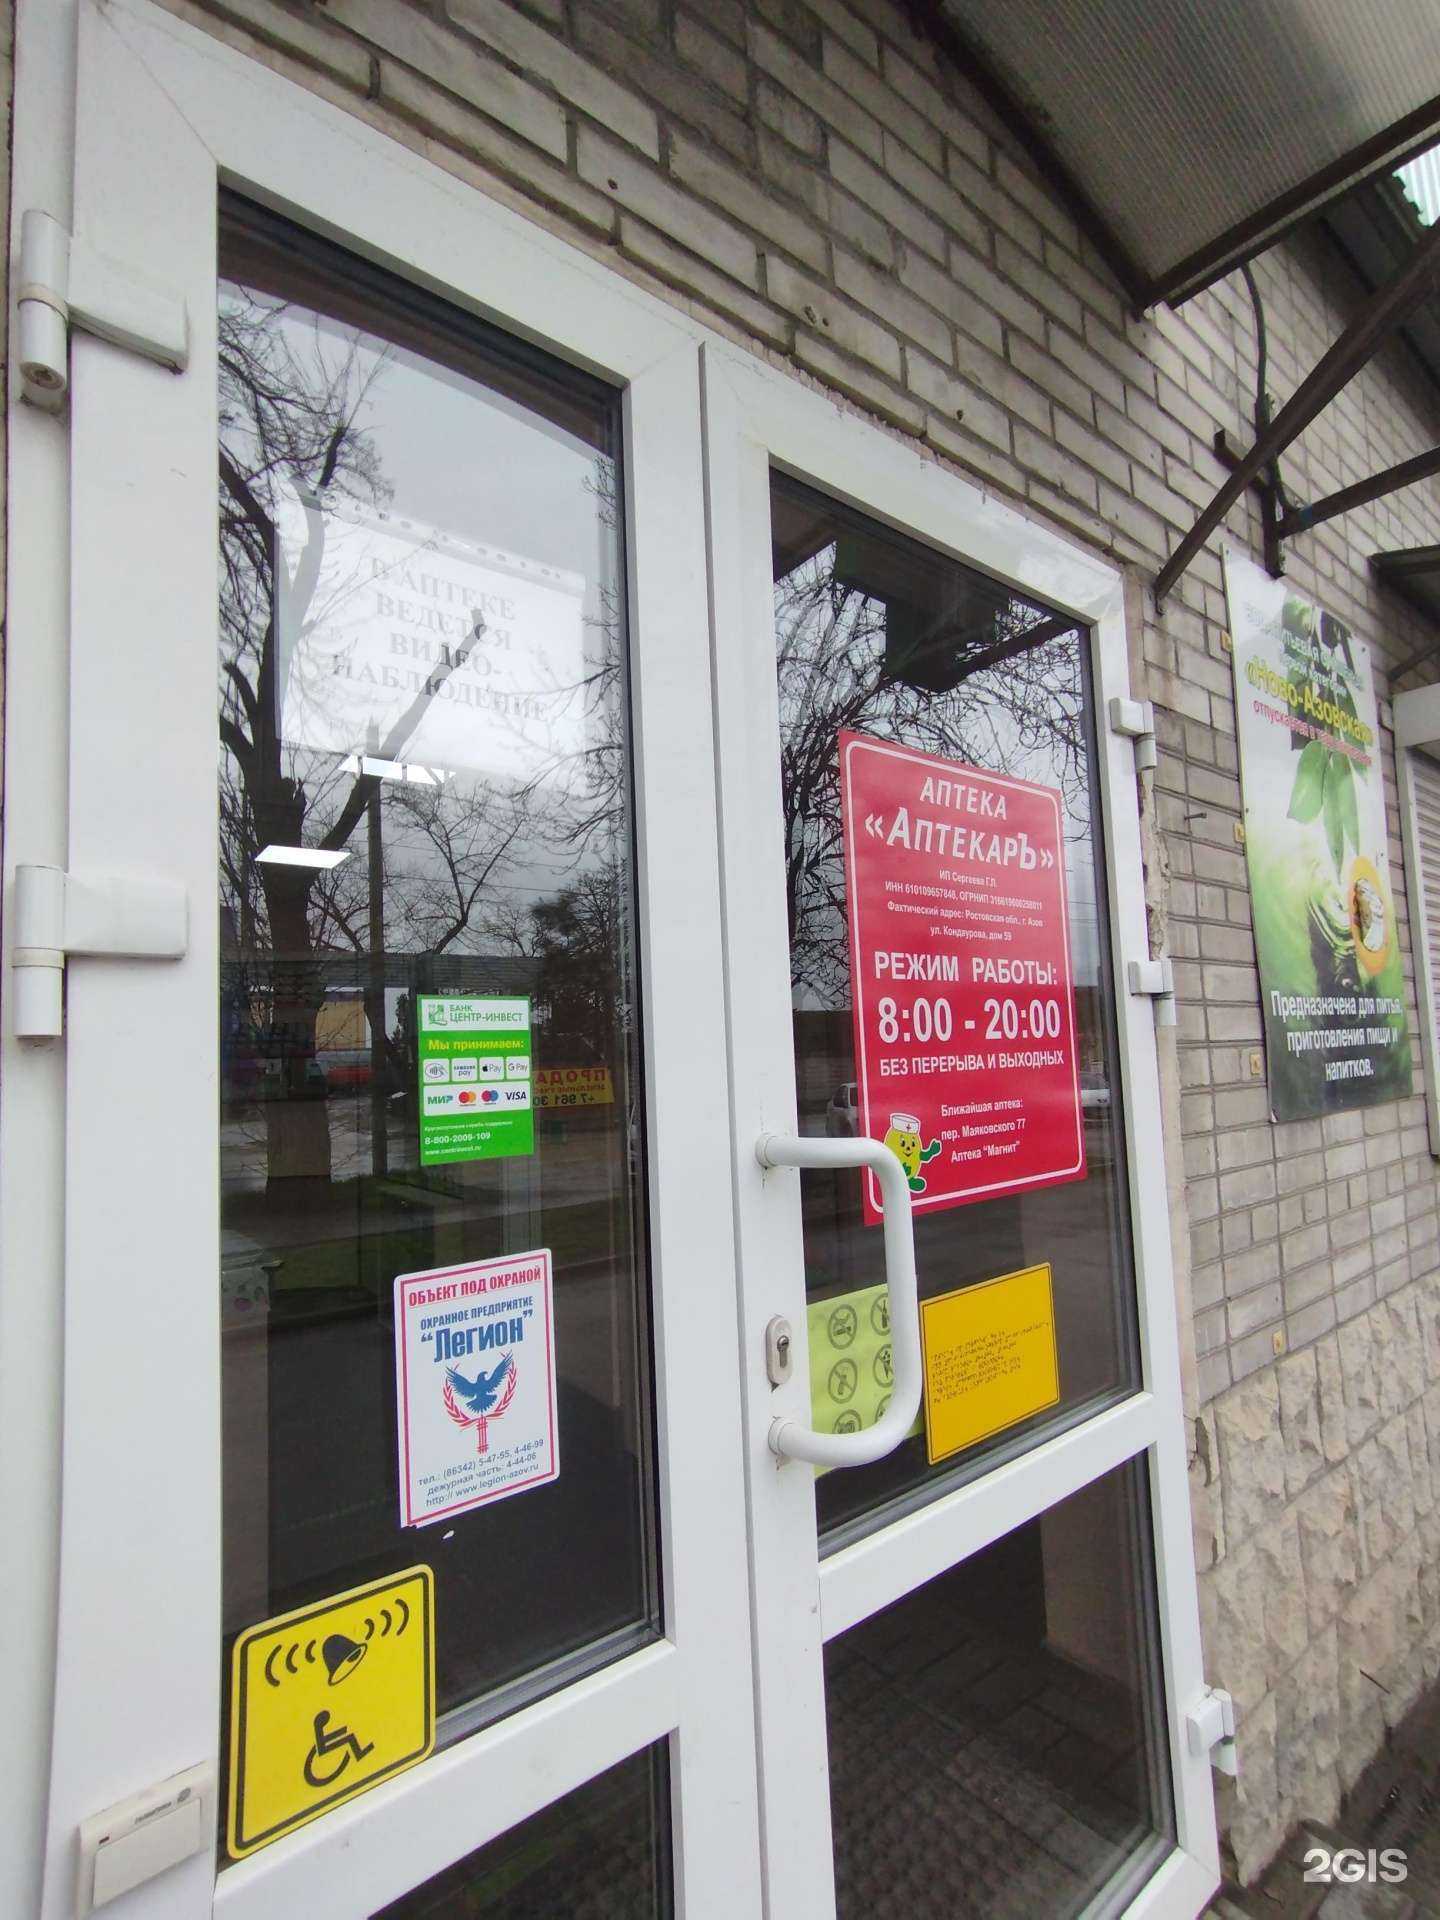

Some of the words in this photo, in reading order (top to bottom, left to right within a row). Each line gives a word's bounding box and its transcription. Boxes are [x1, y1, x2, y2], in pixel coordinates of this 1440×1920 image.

[399, 568, 516, 621] АПТЕКЕ
[919, 776, 1007, 820] АПТЕКА
[939, 869, 951, 881] ИП
[885, 881, 903, 893] ИНН
[887, 900, 939, 916] Фактический
[939, 908, 964, 920] адрес:
[930, 926, 942, 937] ул.
[875, 951, 959, 982] РЕЖИМ
[972, 957, 1058, 985] РАБОТЫ:
[449, 1004, 473, 1012] БАНК
[1271, 990, 1356, 1023] Предназначена
[1358, 998, 1375, 1019] для
[449, 1012, 523, 1023] ЦЕНТР-ИНВЕСТ
[878, 997, 952, 1044] 8:00
[984, 998, 1061, 1040] 20:00
[428, 1039, 449, 1050] Мы
[453, 1040, 524, 1051] принимаем:
[1287, 1027, 1365, 1058] приготовления
[1367, 1027, 1390, 1047] пищи
[880, 1057, 908, 1077] БЕЗ
[912, 1054, 985, 1075] ПЕРЕРЫВА
[987, 1054, 997, 1070] И
[999, 1050, 1064, 1071] ВЫХОДНЫХ
[1325, 1058, 1374, 1081] напитков.
[427, 1095, 454, 1105] МИР
[505, 1091, 527, 1101] VISA
[941, 1101, 993, 1117] Ближайшая
[994, 1098, 1024, 1111] аптека:
[941, 1128, 960, 1141] пер.
[962, 1121, 1016, 1138] Маяковского
[1016, 1118, 1026, 1130] 77
[951, 1147, 982, 1164] Аптека
[409, 1283, 458, 1307] ОБЪЕКТ
[461, 1278, 487, 1297] ПОД
[489, 1266, 541, 1290] ОХРАНОЙ
[420, 1310, 470, 1331] ОХРАННОЕ
[471, 1296, 533, 1320] ПРЕДПРИЯТИЕ
[443, 1461, 476, 1478] (86342)
[427, 1474, 473, 1496] дежурная
